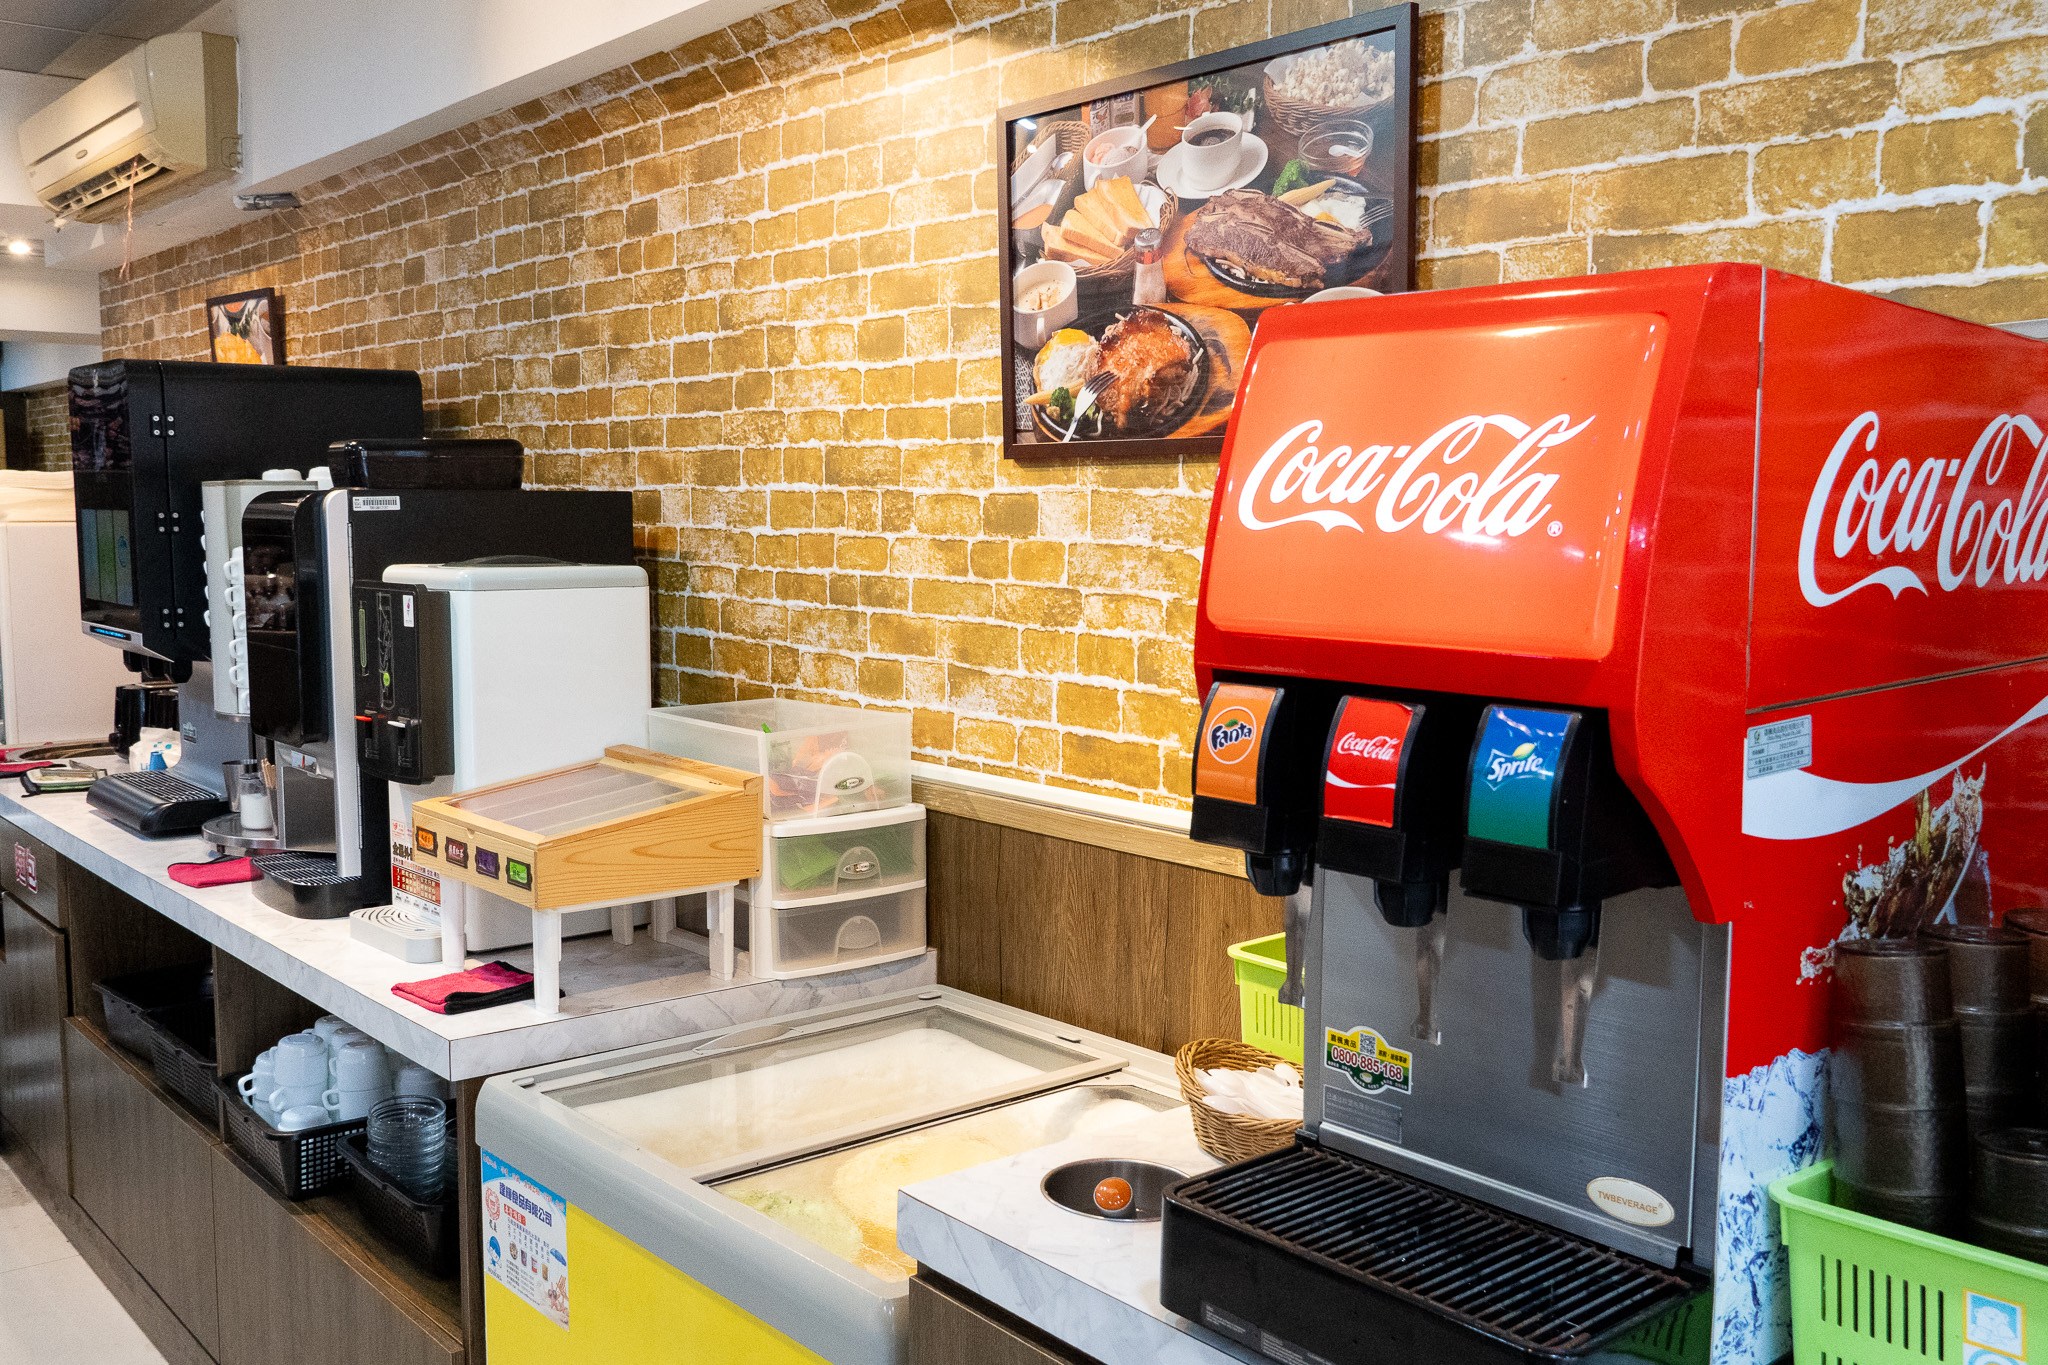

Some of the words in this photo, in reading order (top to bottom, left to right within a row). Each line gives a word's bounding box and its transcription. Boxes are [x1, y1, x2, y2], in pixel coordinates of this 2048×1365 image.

[1238, 413, 1596, 538] Coca-Cola
[1211, 722, 1253, 752] Fanta
[1486, 752, 1545, 783] Sprite
[1597, 1190, 1659, 1215] TWBEVERAGE
